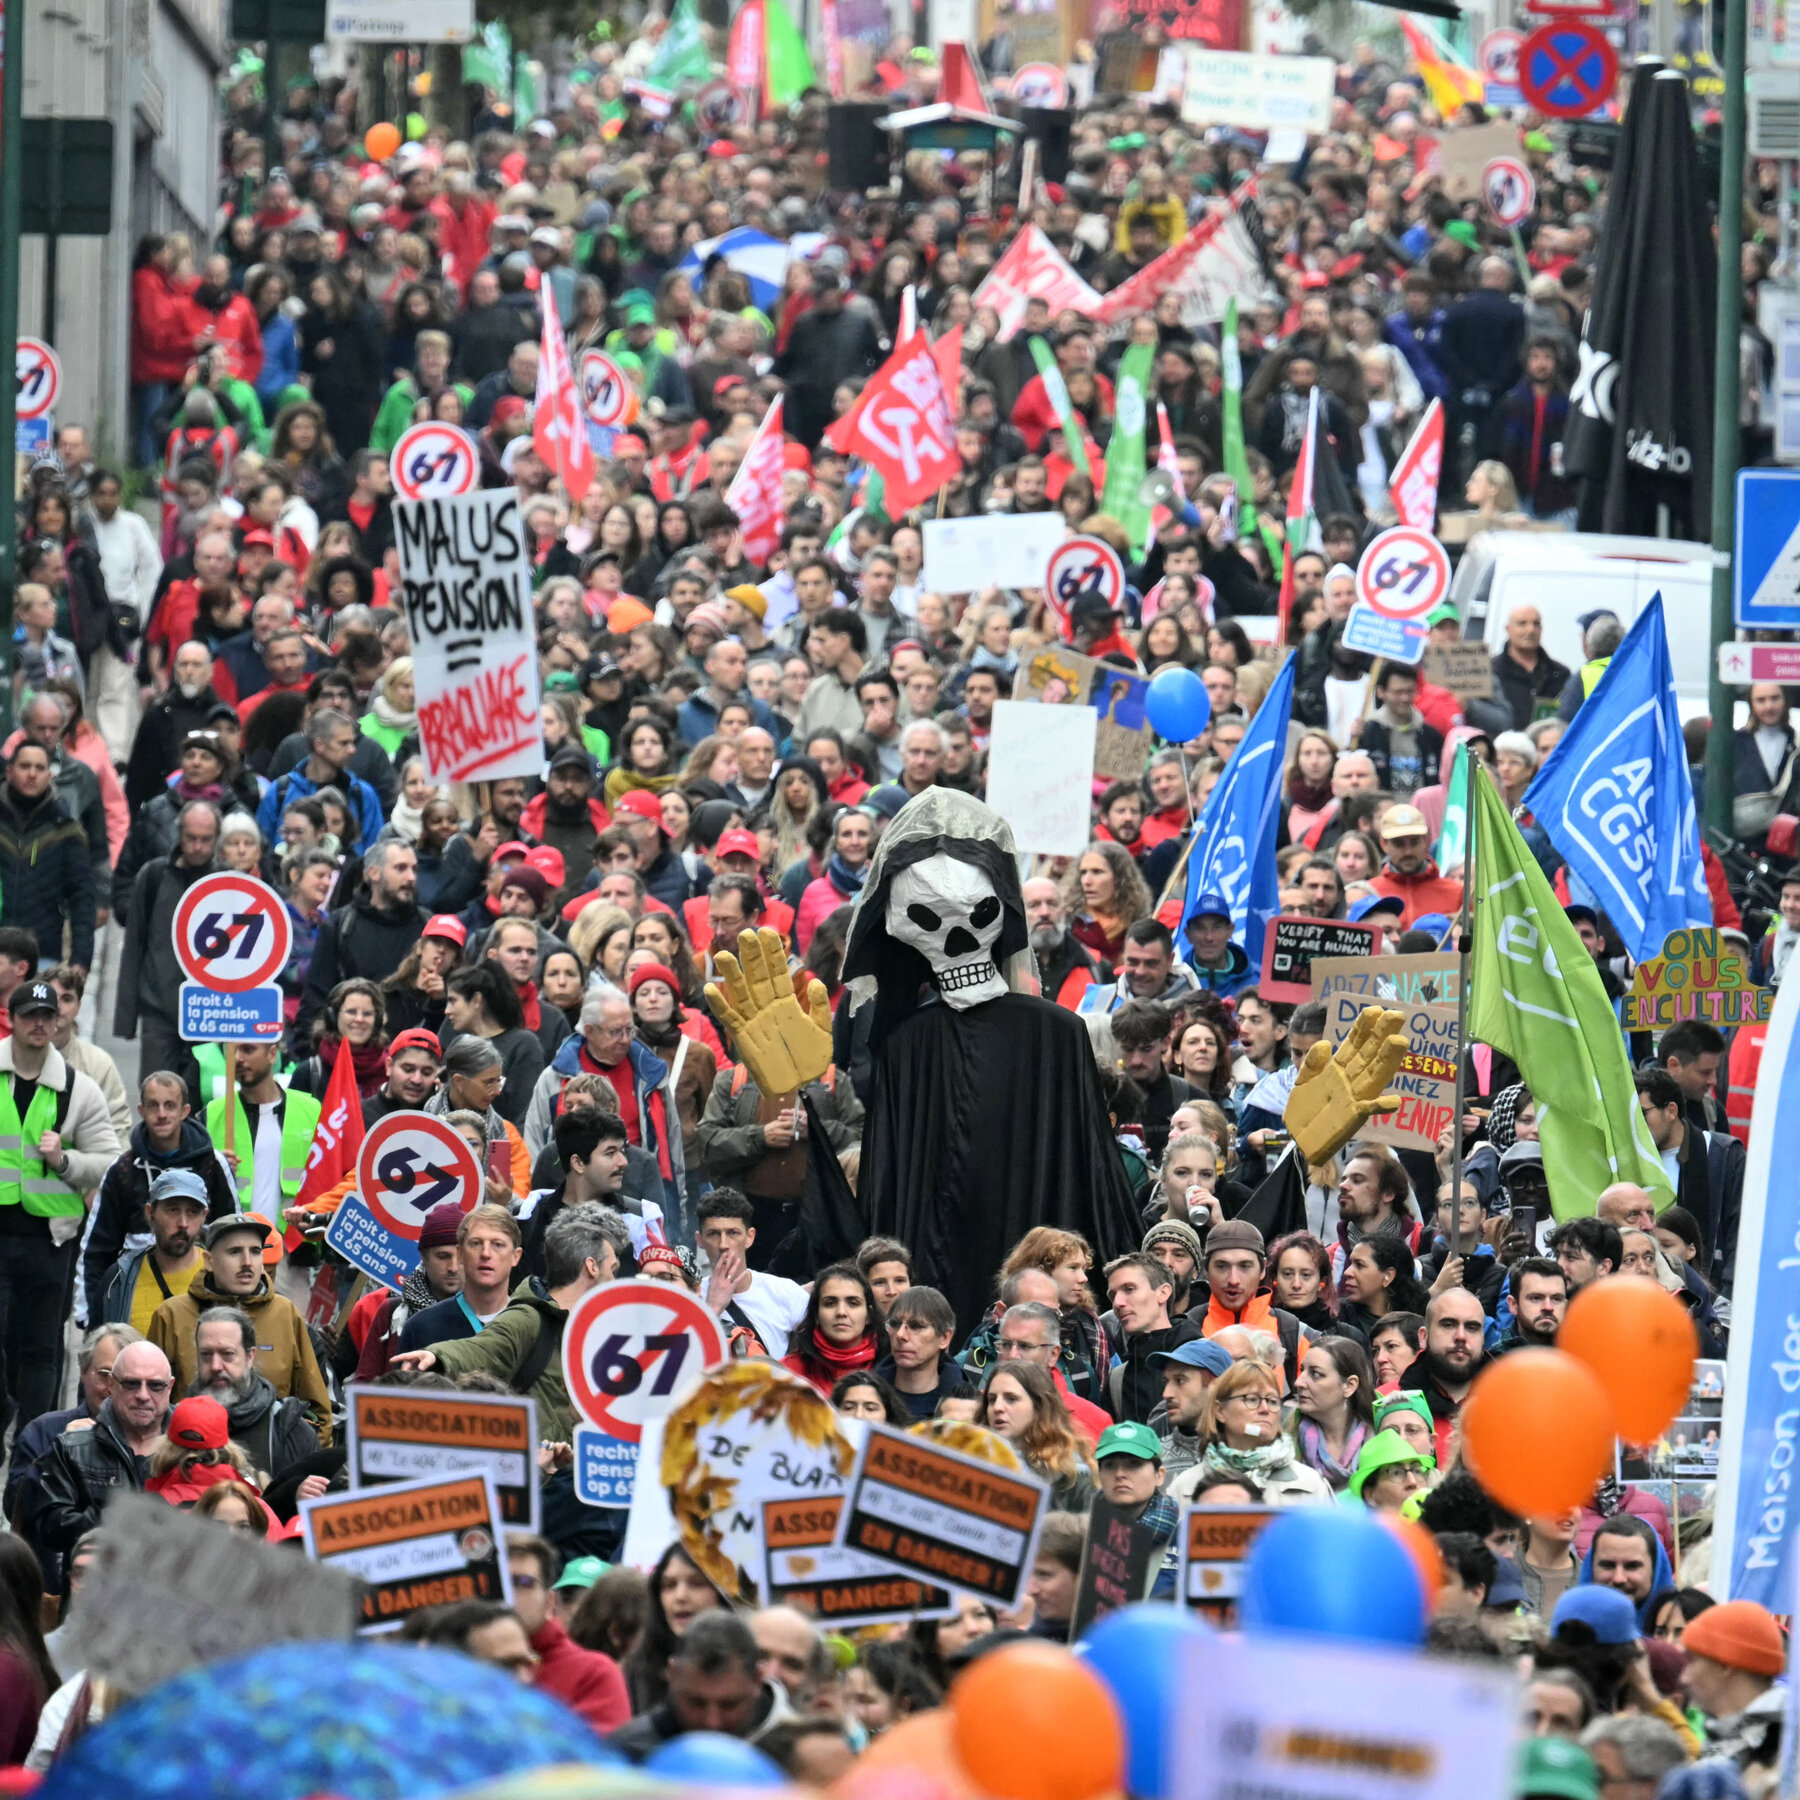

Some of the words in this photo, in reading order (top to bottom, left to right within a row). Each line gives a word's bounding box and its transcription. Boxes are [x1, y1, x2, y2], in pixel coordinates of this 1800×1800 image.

[410, 453, 457, 483] 67
[398, 498, 519, 578] MALUS
[1058, 565, 1104, 600] 67
[1375, 557, 1430, 594] 67
[403, 573, 522, 643] PENSION
[194, 913, 264, 959] 67
[1276, 935, 1297, 947] YOU
[1299, 940, 1321, 952] ARE
[1325, 941, 1370, 955] HUMAN
[1279, 923, 1325, 939] VERIFY
[1336, 930, 1372, 945] THAT
[1663, 928, 1717, 960] ON
[1639, 958, 1741, 991] VOUS
[188, 994, 221, 1006] droit
[188, 1006, 200, 1018] la
[203, 1007, 259, 1023] pension
[1621, 990, 1774, 1027] ENCULTURE
[188, 1020, 197, 1032] à
[199, 1020, 216, 1032] 65
[219, 1022, 245, 1033] ans
[1410, 1013, 1459, 1040] QUE
[378, 1146, 460, 1212] 67
[340, 1216, 353, 1233] la
[352, 1227, 407, 1271] pension
[346, 1208, 381, 1236] droit
[378, 1232, 389, 1244] à
[334, 1231, 345, 1243] à
[344, 1237, 361, 1256] 65
[361, 1253, 388, 1275] ans
[591, 1333, 690, 1397] 67
[365, 1408, 521, 1439] ASSOCIATION
[586, 1443, 639, 1460] recht
[709, 1435, 750, 1467] DE
[586, 1462, 636, 1478] pens
[874, 1449, 1029, 1516] ASSOCIATION
[586, 1480, 611, 1498] op
[1745, 1411, 1799, 1569] Maison
[321, 1494, 482, 1539] ASSOCIATION
[861, 1522, 894, 1551] EN
[896, 1535, 992, 1586] DANGER
[378, 1575, 475, 1615] DANGER
